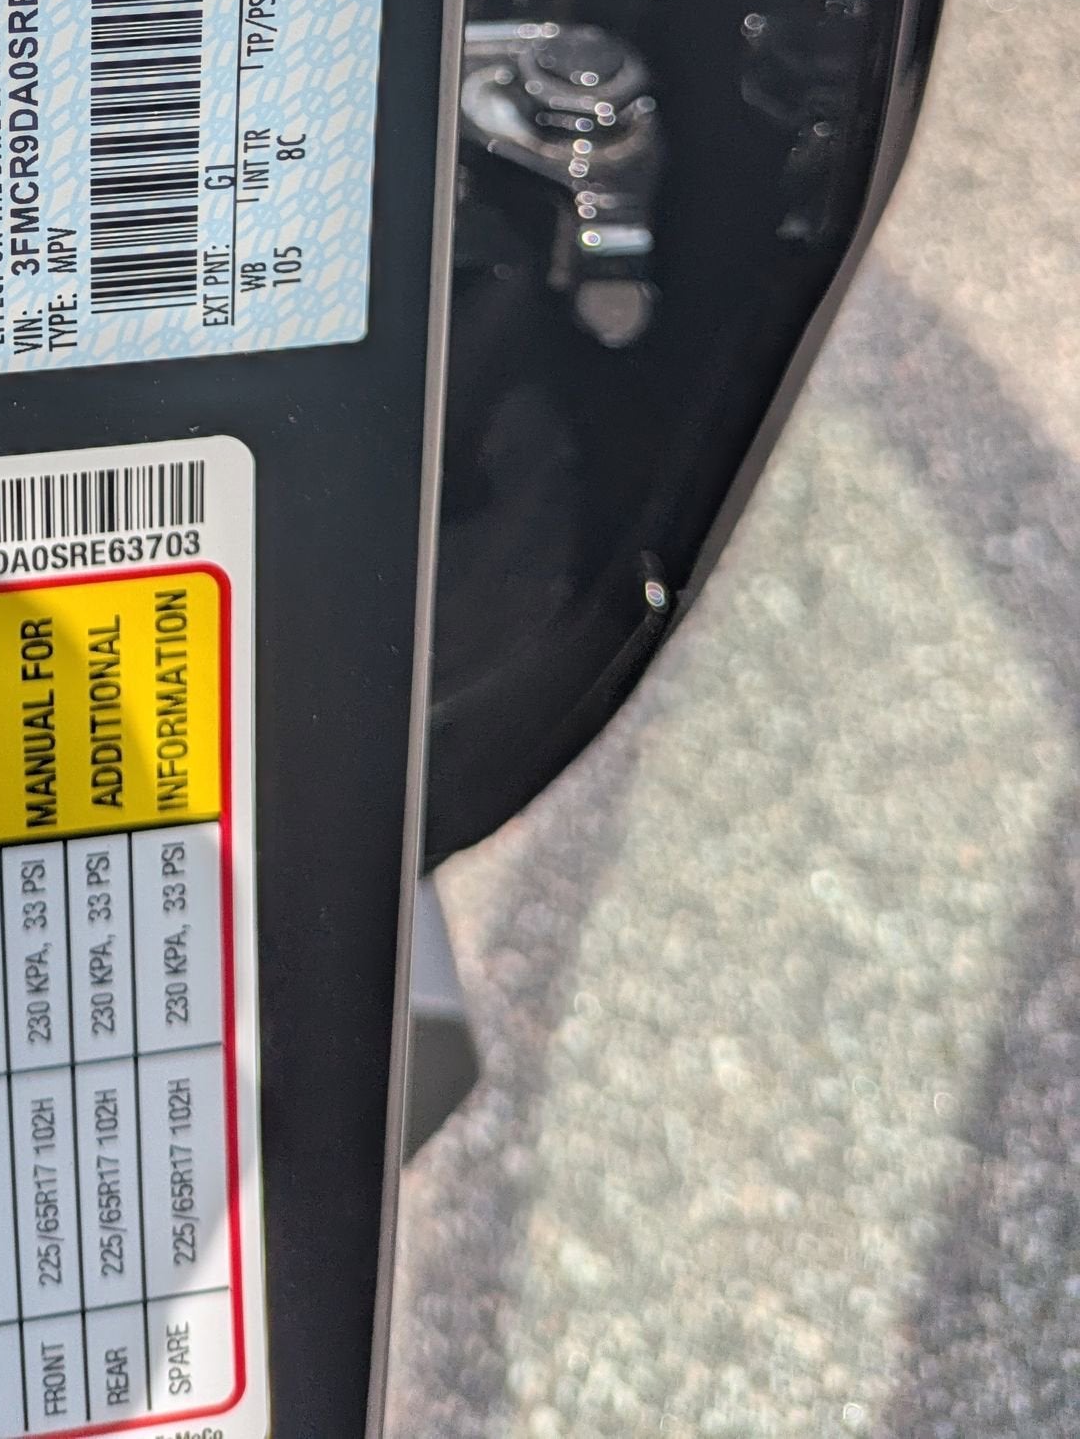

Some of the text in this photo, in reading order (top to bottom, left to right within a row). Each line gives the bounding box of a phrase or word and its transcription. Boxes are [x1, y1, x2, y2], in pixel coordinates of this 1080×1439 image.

[242, 128, 271, 191] INT TR
[275, 133, 307, 161] 8C
[46, 227, 78, 353] TYPE: MPV
[202, 244, 230, 327] EXT PNT:
[240, 262, 267, 293] WB
[272, 246, 302, 288] 105
[13, 309, 43, 355] VIN:
[20, 619, 57, 829] MANUAL FOR
[88, 617, 124, 809] ADDITIONAL
[154, 589, 188, 814] INFORMATION
[20, 859, 52, 1045] 230 33 PSI
[85, 851, 116, 1036] 230 33 PSI
[161, 841, 189, 1026] 230 33 PSI
[31, 1097, 64, 1287] 225/65R17 102H
[94, 1088, 127, 1277] 225/65R17 102H
[167, 1078, 199, 1267] 225/65R17 102H
[41, 1342, 67, 1417] FRONT
[104, 1347, 130, 1407] REAR
[161, 1316, 192, 1396] SPARE
